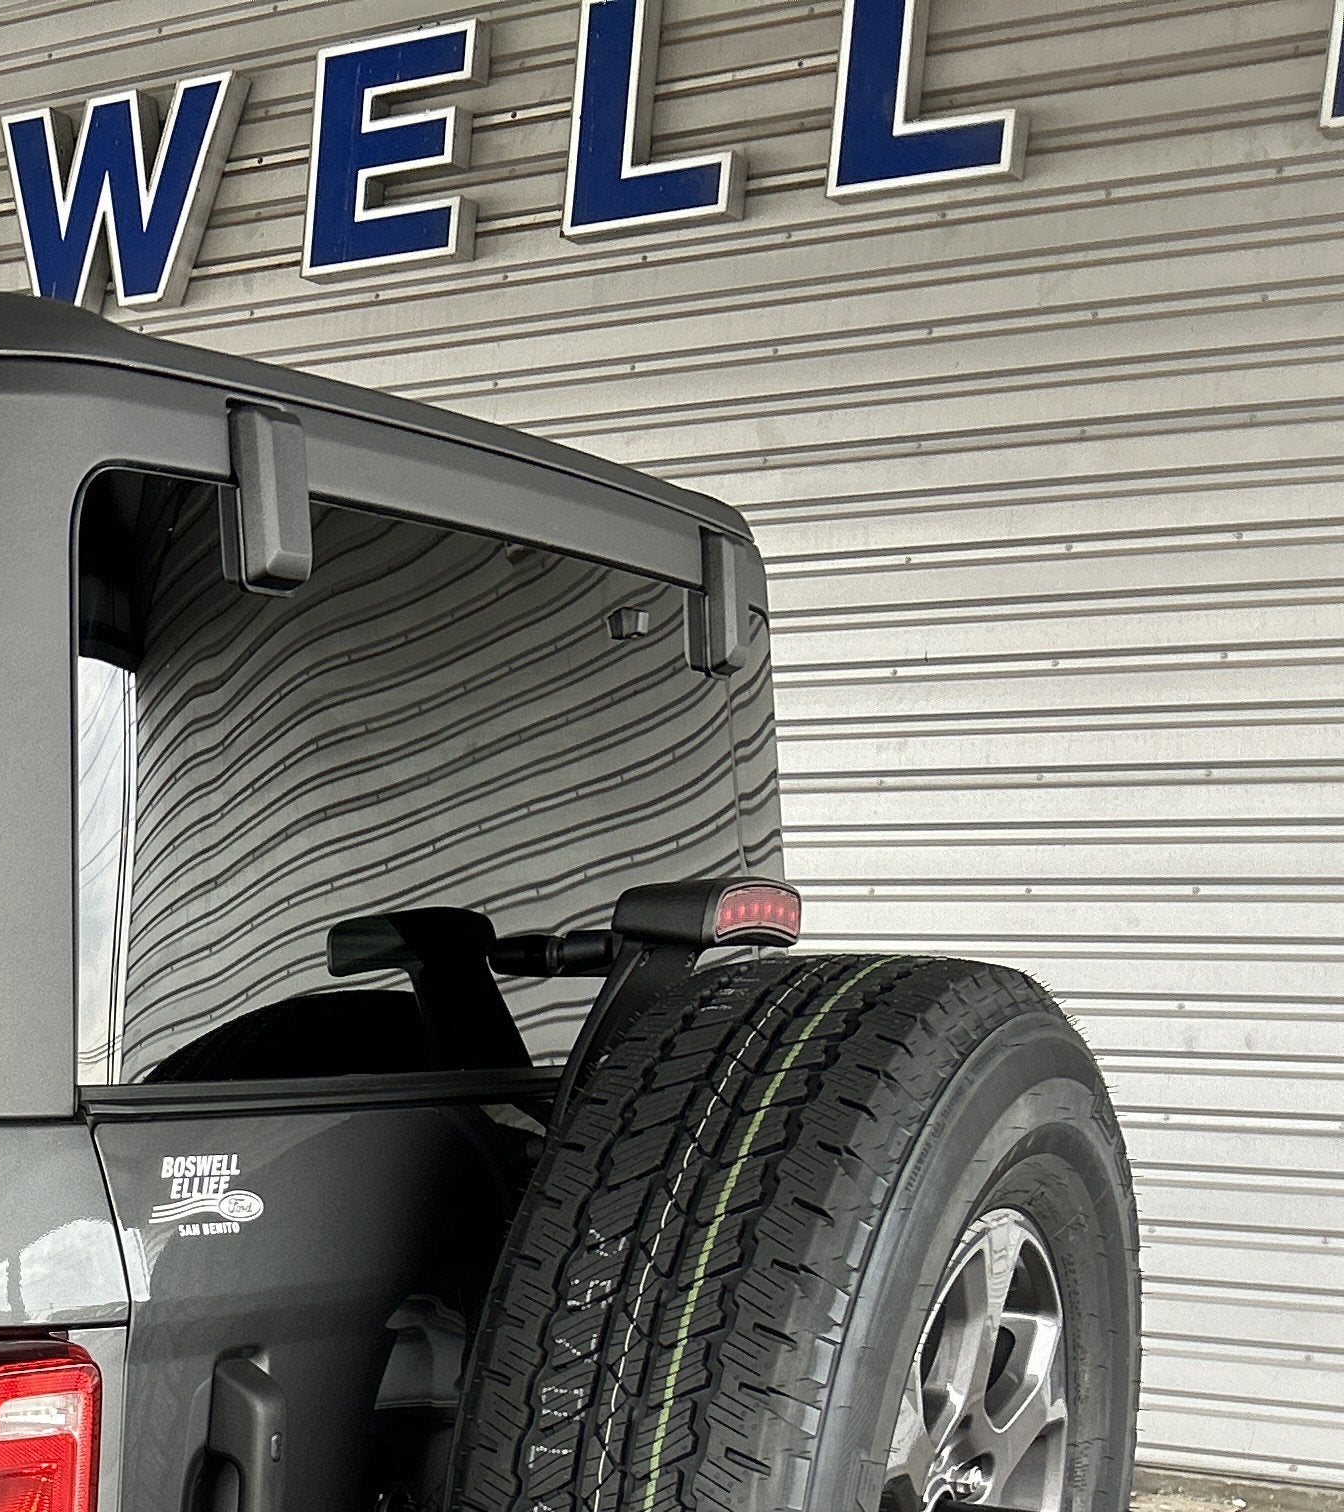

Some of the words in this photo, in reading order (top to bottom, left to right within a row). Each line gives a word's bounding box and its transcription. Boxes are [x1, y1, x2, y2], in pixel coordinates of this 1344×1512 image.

[161, 1154, 240, 1179] BOSWELL
[170, 1176, 230, 1199] ELLIFF
[178, 1223, 201, 1237] SAN
[202, 1221, 240, 1236] BENITO
